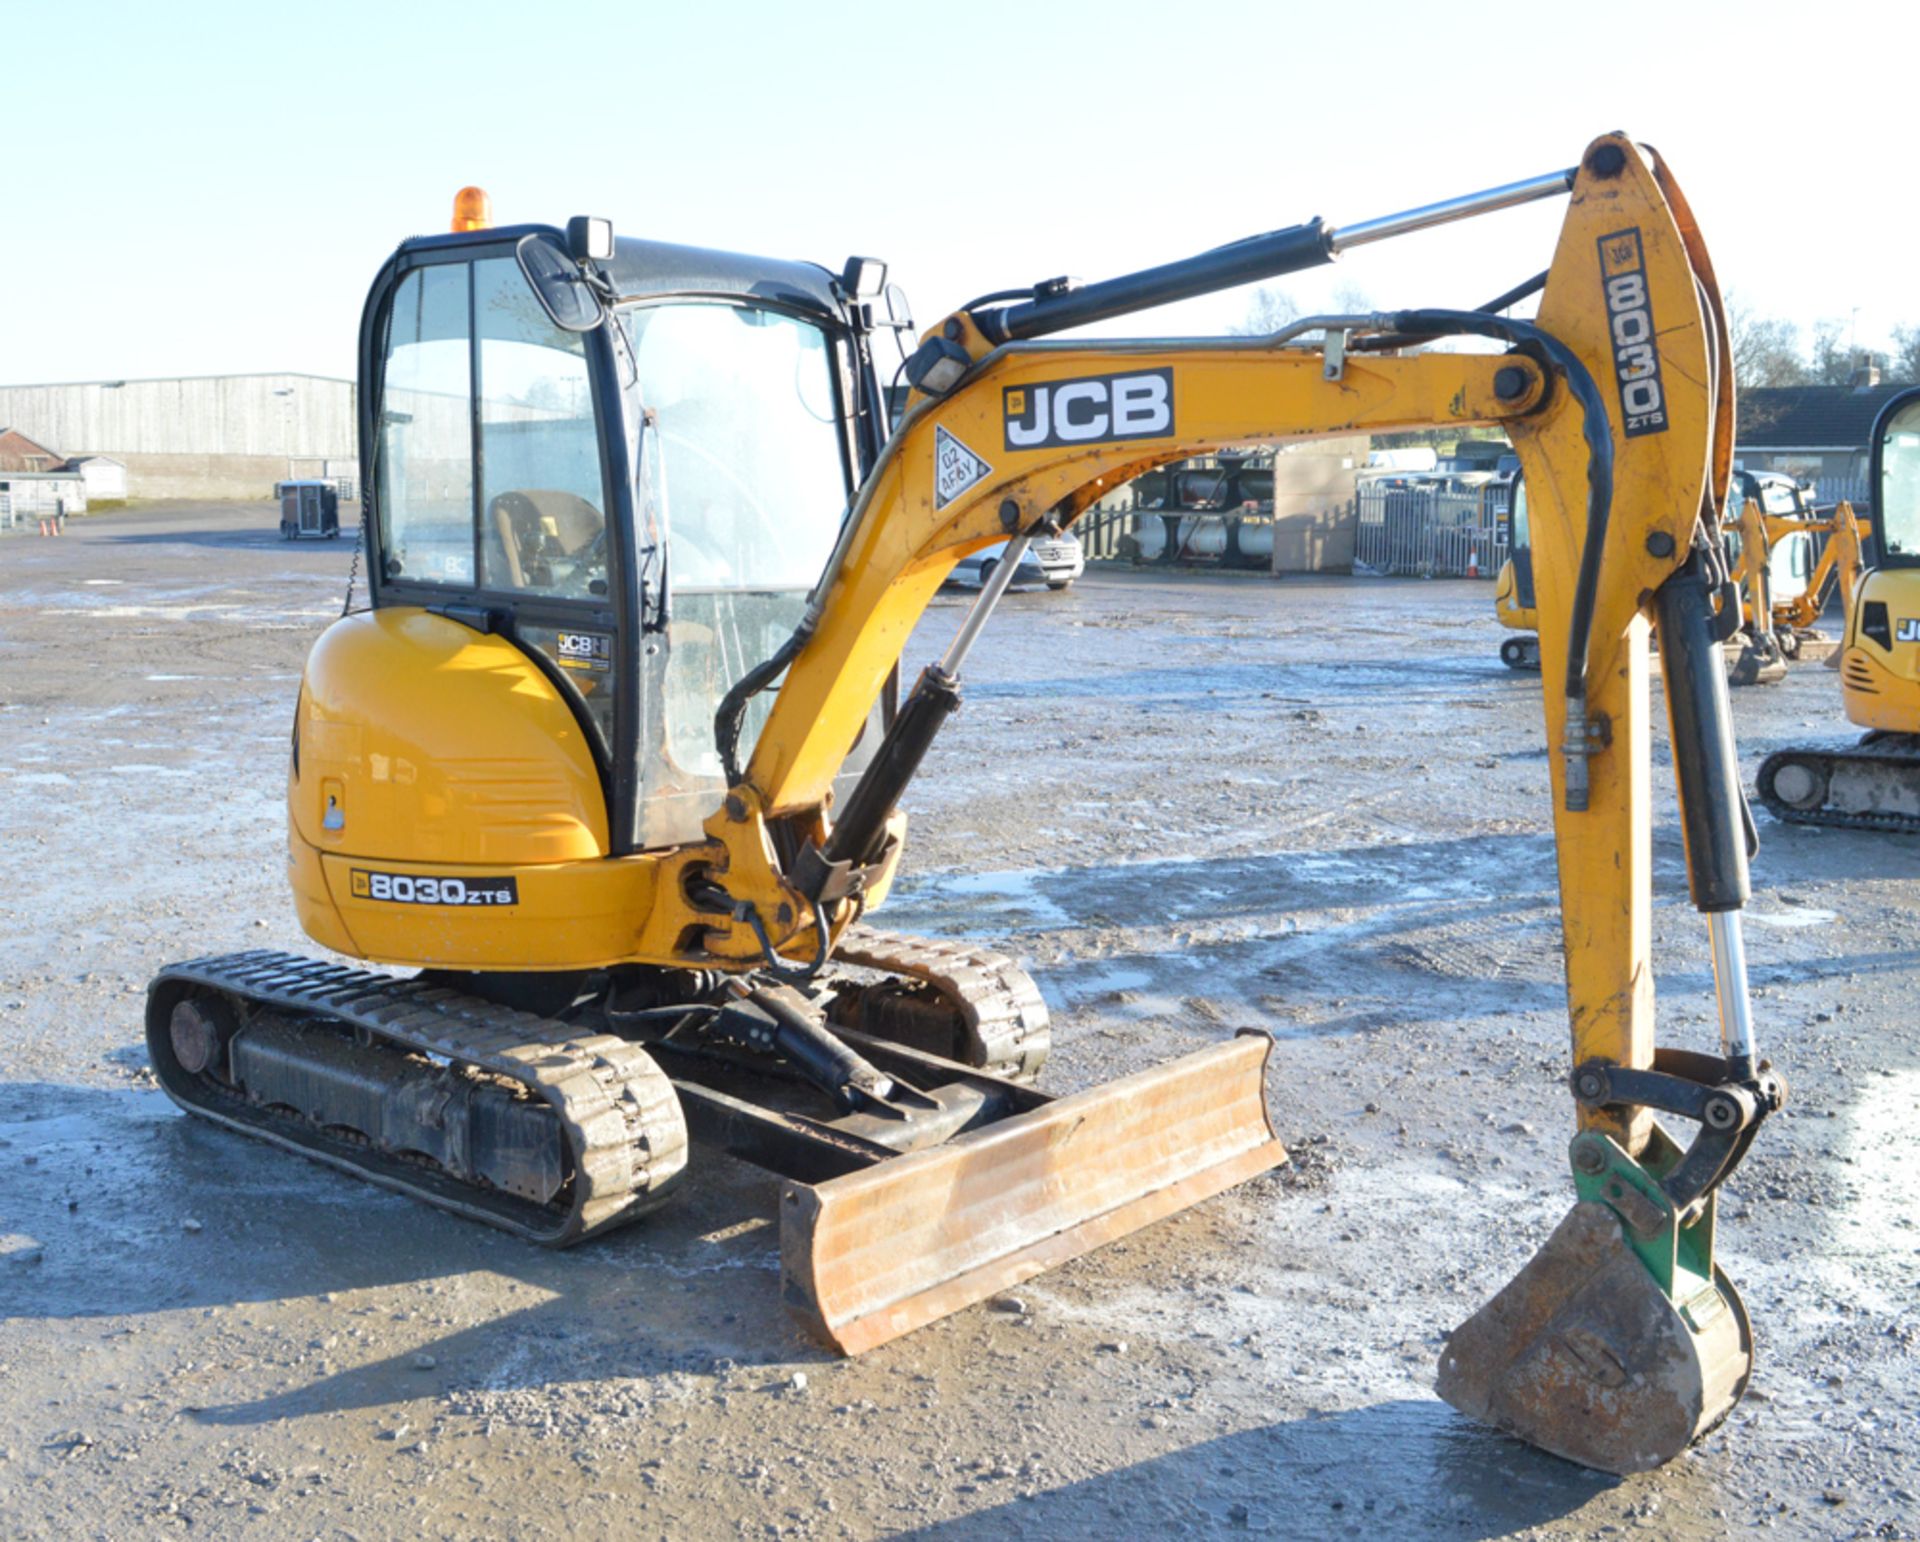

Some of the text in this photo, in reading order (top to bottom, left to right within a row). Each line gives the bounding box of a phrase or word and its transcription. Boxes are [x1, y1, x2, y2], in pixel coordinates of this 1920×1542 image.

[1608, 274, 1660, 415] 8030
[1008, 374, 1170, 446] JCB
[1627, 412, 1664, 430] ZTS
[1897, 619, 1920, 641] J
[558, 634, 592, 652] JCB
